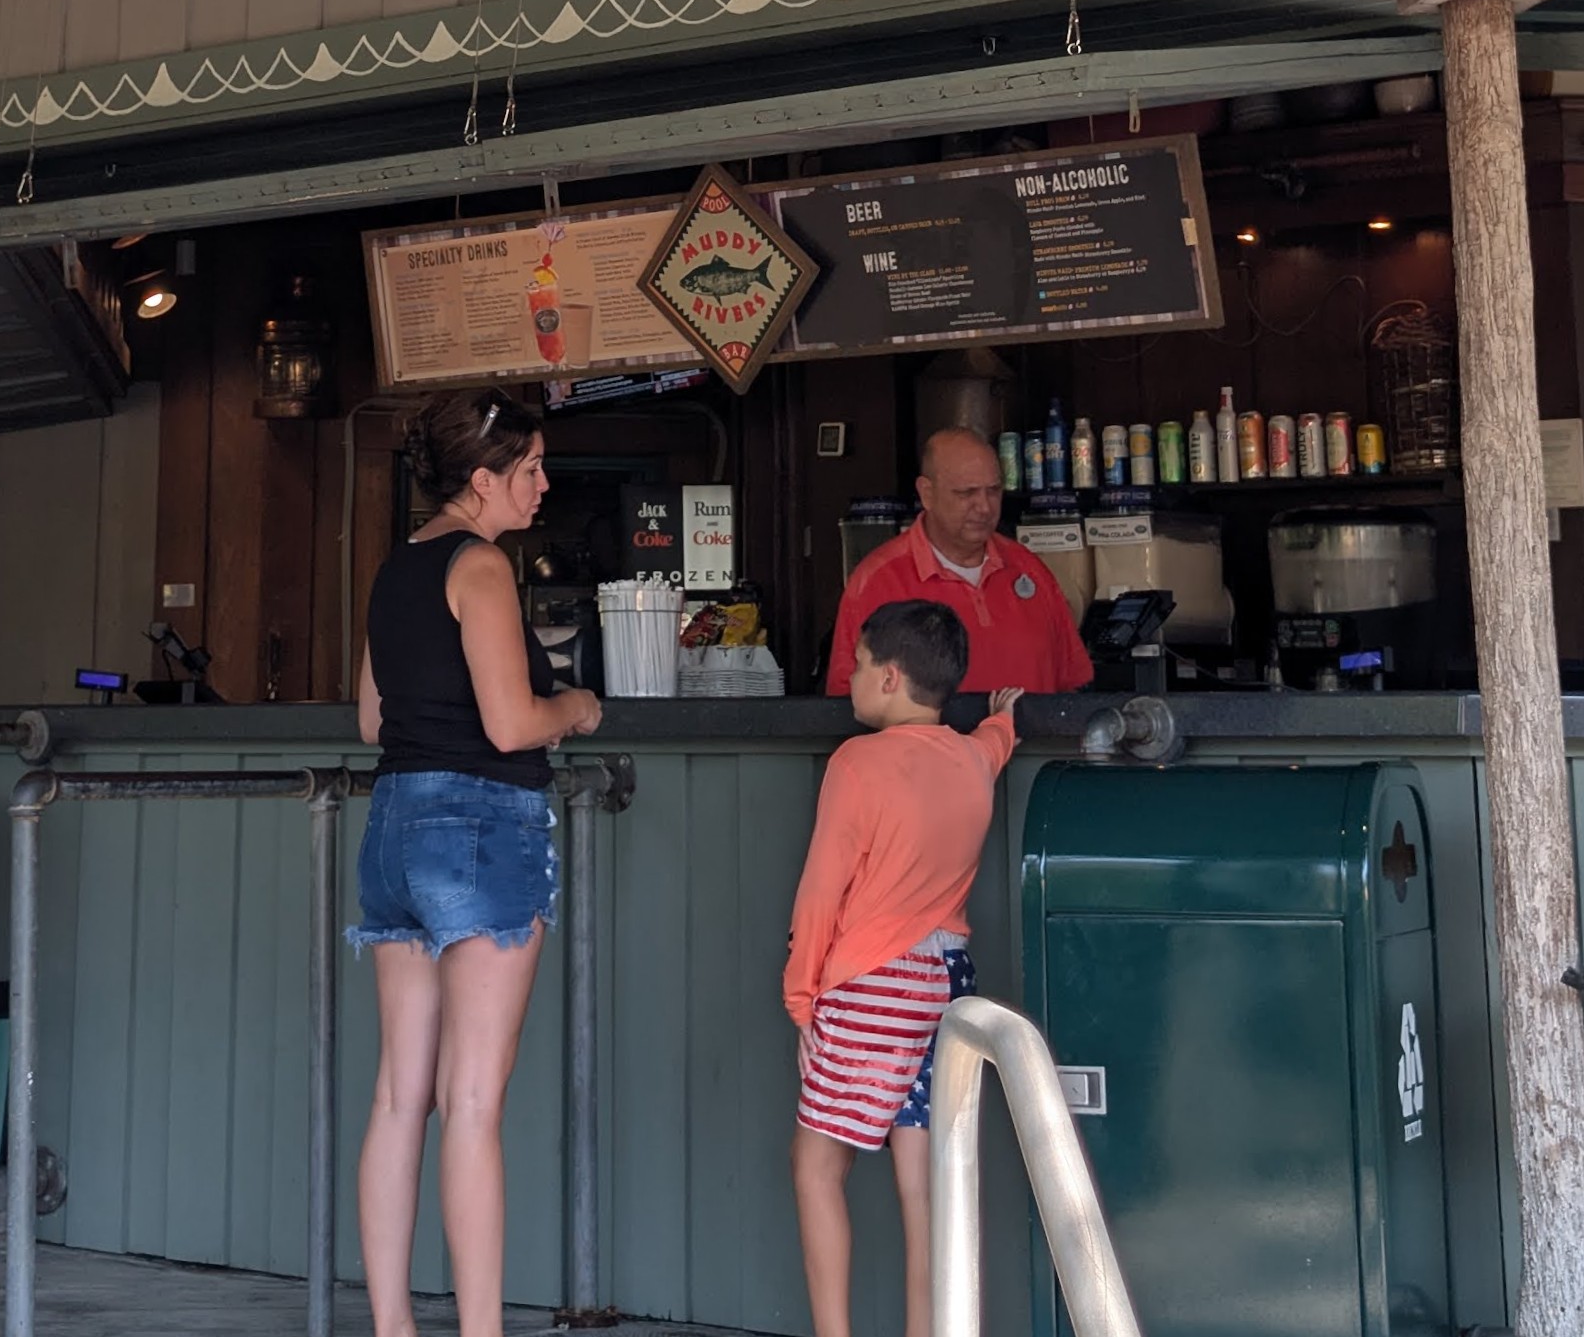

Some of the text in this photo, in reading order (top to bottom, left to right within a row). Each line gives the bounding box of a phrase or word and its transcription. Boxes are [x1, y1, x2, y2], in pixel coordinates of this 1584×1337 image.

[1015, 164, 1130, 197] NON-ALCOHOLIC
[702, 195, 730, 211] POOL
[846, 201, 882, 223] BEER
[408, 240, 508, 270] SPECIALTY DRINKS
[681, 230, 762, 264] MUDDY
[862, 251, 898, 273] WINE
[692, 292, 765, 324] RIVERS
[722, 345, 747, 359] BAR
[1299, 430, 1307, 468] TRULY
[637, 502, 667, 518] JACK
[694, 501, 732, 516] Rum
[648, 518, 659, 530] &
[632, 531, 674, 547] Coke
[693, 530, 733, 545] Coke
[636, 570, 733, 583] FROZEN
